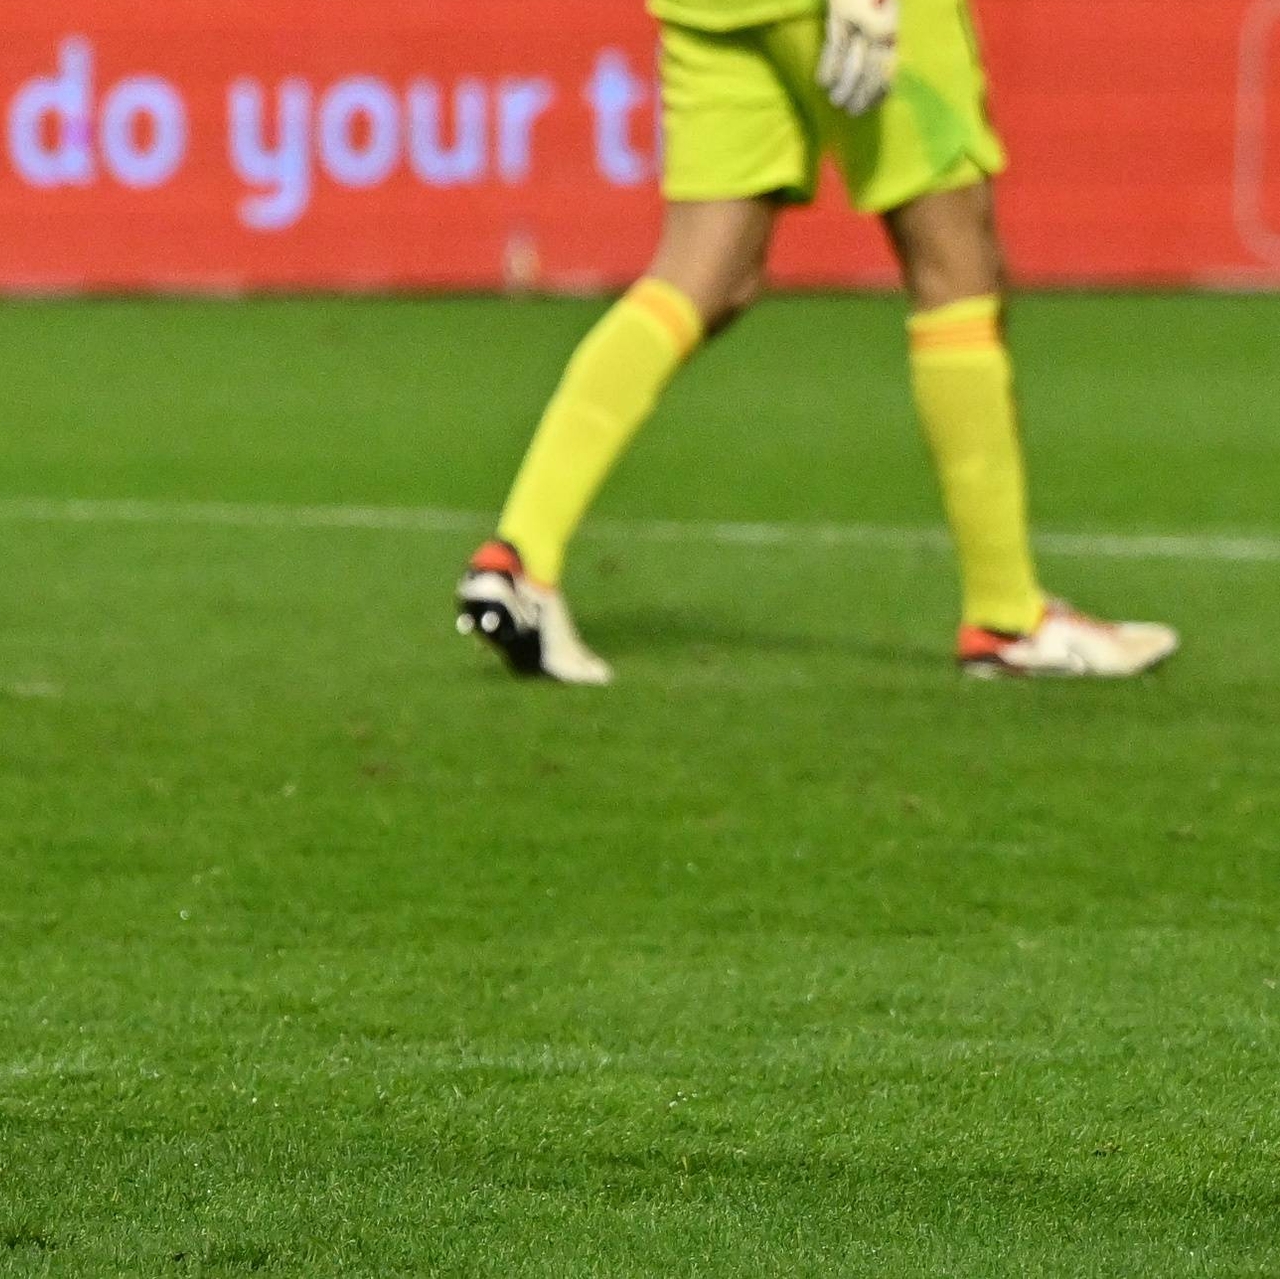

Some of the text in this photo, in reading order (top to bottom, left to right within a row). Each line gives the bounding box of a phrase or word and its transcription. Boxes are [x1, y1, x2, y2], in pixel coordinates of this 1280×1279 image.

[8, 35, 656, 228] do your t
